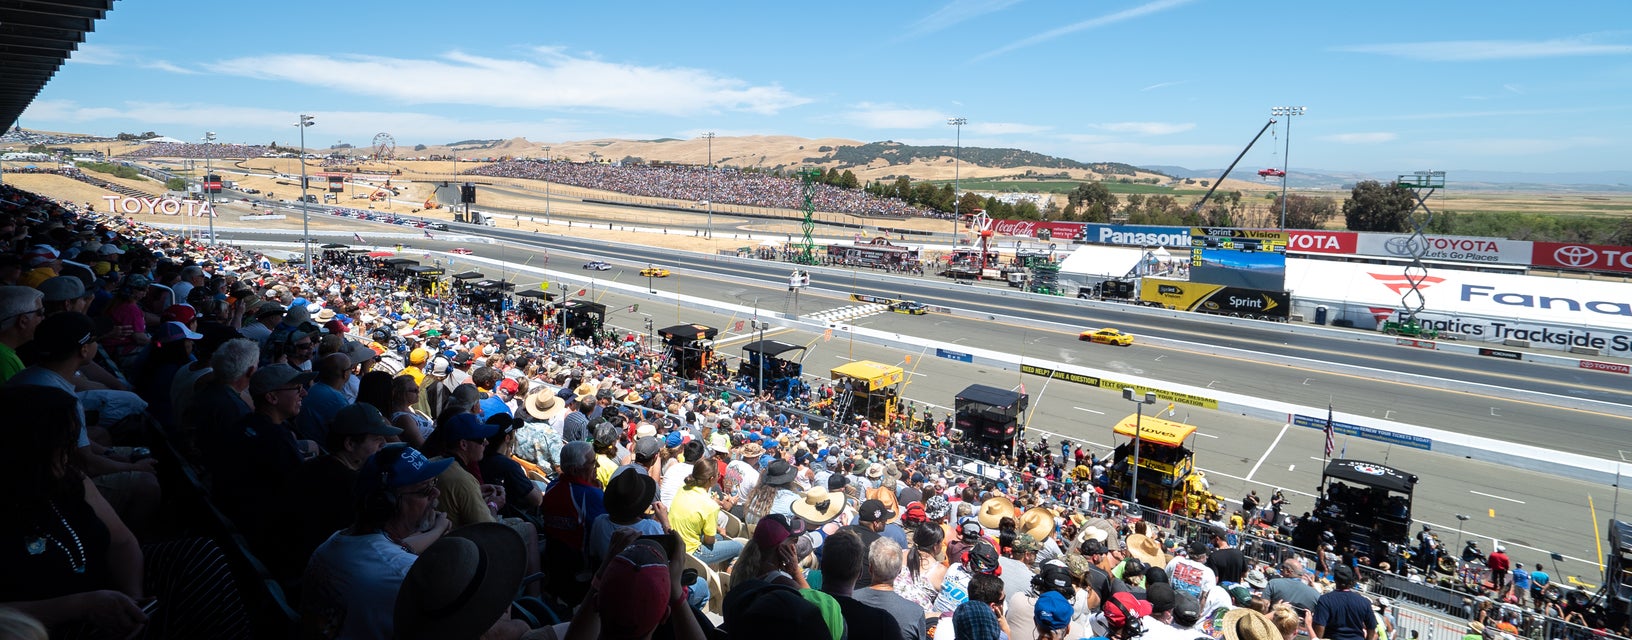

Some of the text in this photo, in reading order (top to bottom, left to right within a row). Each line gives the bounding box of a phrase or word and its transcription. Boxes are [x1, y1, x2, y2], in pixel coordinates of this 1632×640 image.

[102, 195, 218, 217] TOYOTA
[1208, 228, 1280, 239] Sprint Vision
[1288, 234, 1341, 250] YOTA
[1427, 238, 1499, 253] TOYOTA
[1425, 251, 1499, 262] Let's Go Places
[1229, 295, 1262, 308] Sprint
[1398, 312, 1483, 335] Fnatics
[1491, 322, 1605, 350] Trackside
[1595, 363, 1628, 372] TOYOTA
[1022, 365, 1035, 373] NEED
[1035, 367, 1050, 376] HELP?
[1070, 374, 1098, 385] QUESTION?
[1101, 380, 1115, 388] TEXT
[1174, 397, 1204, 407] LOCATION
